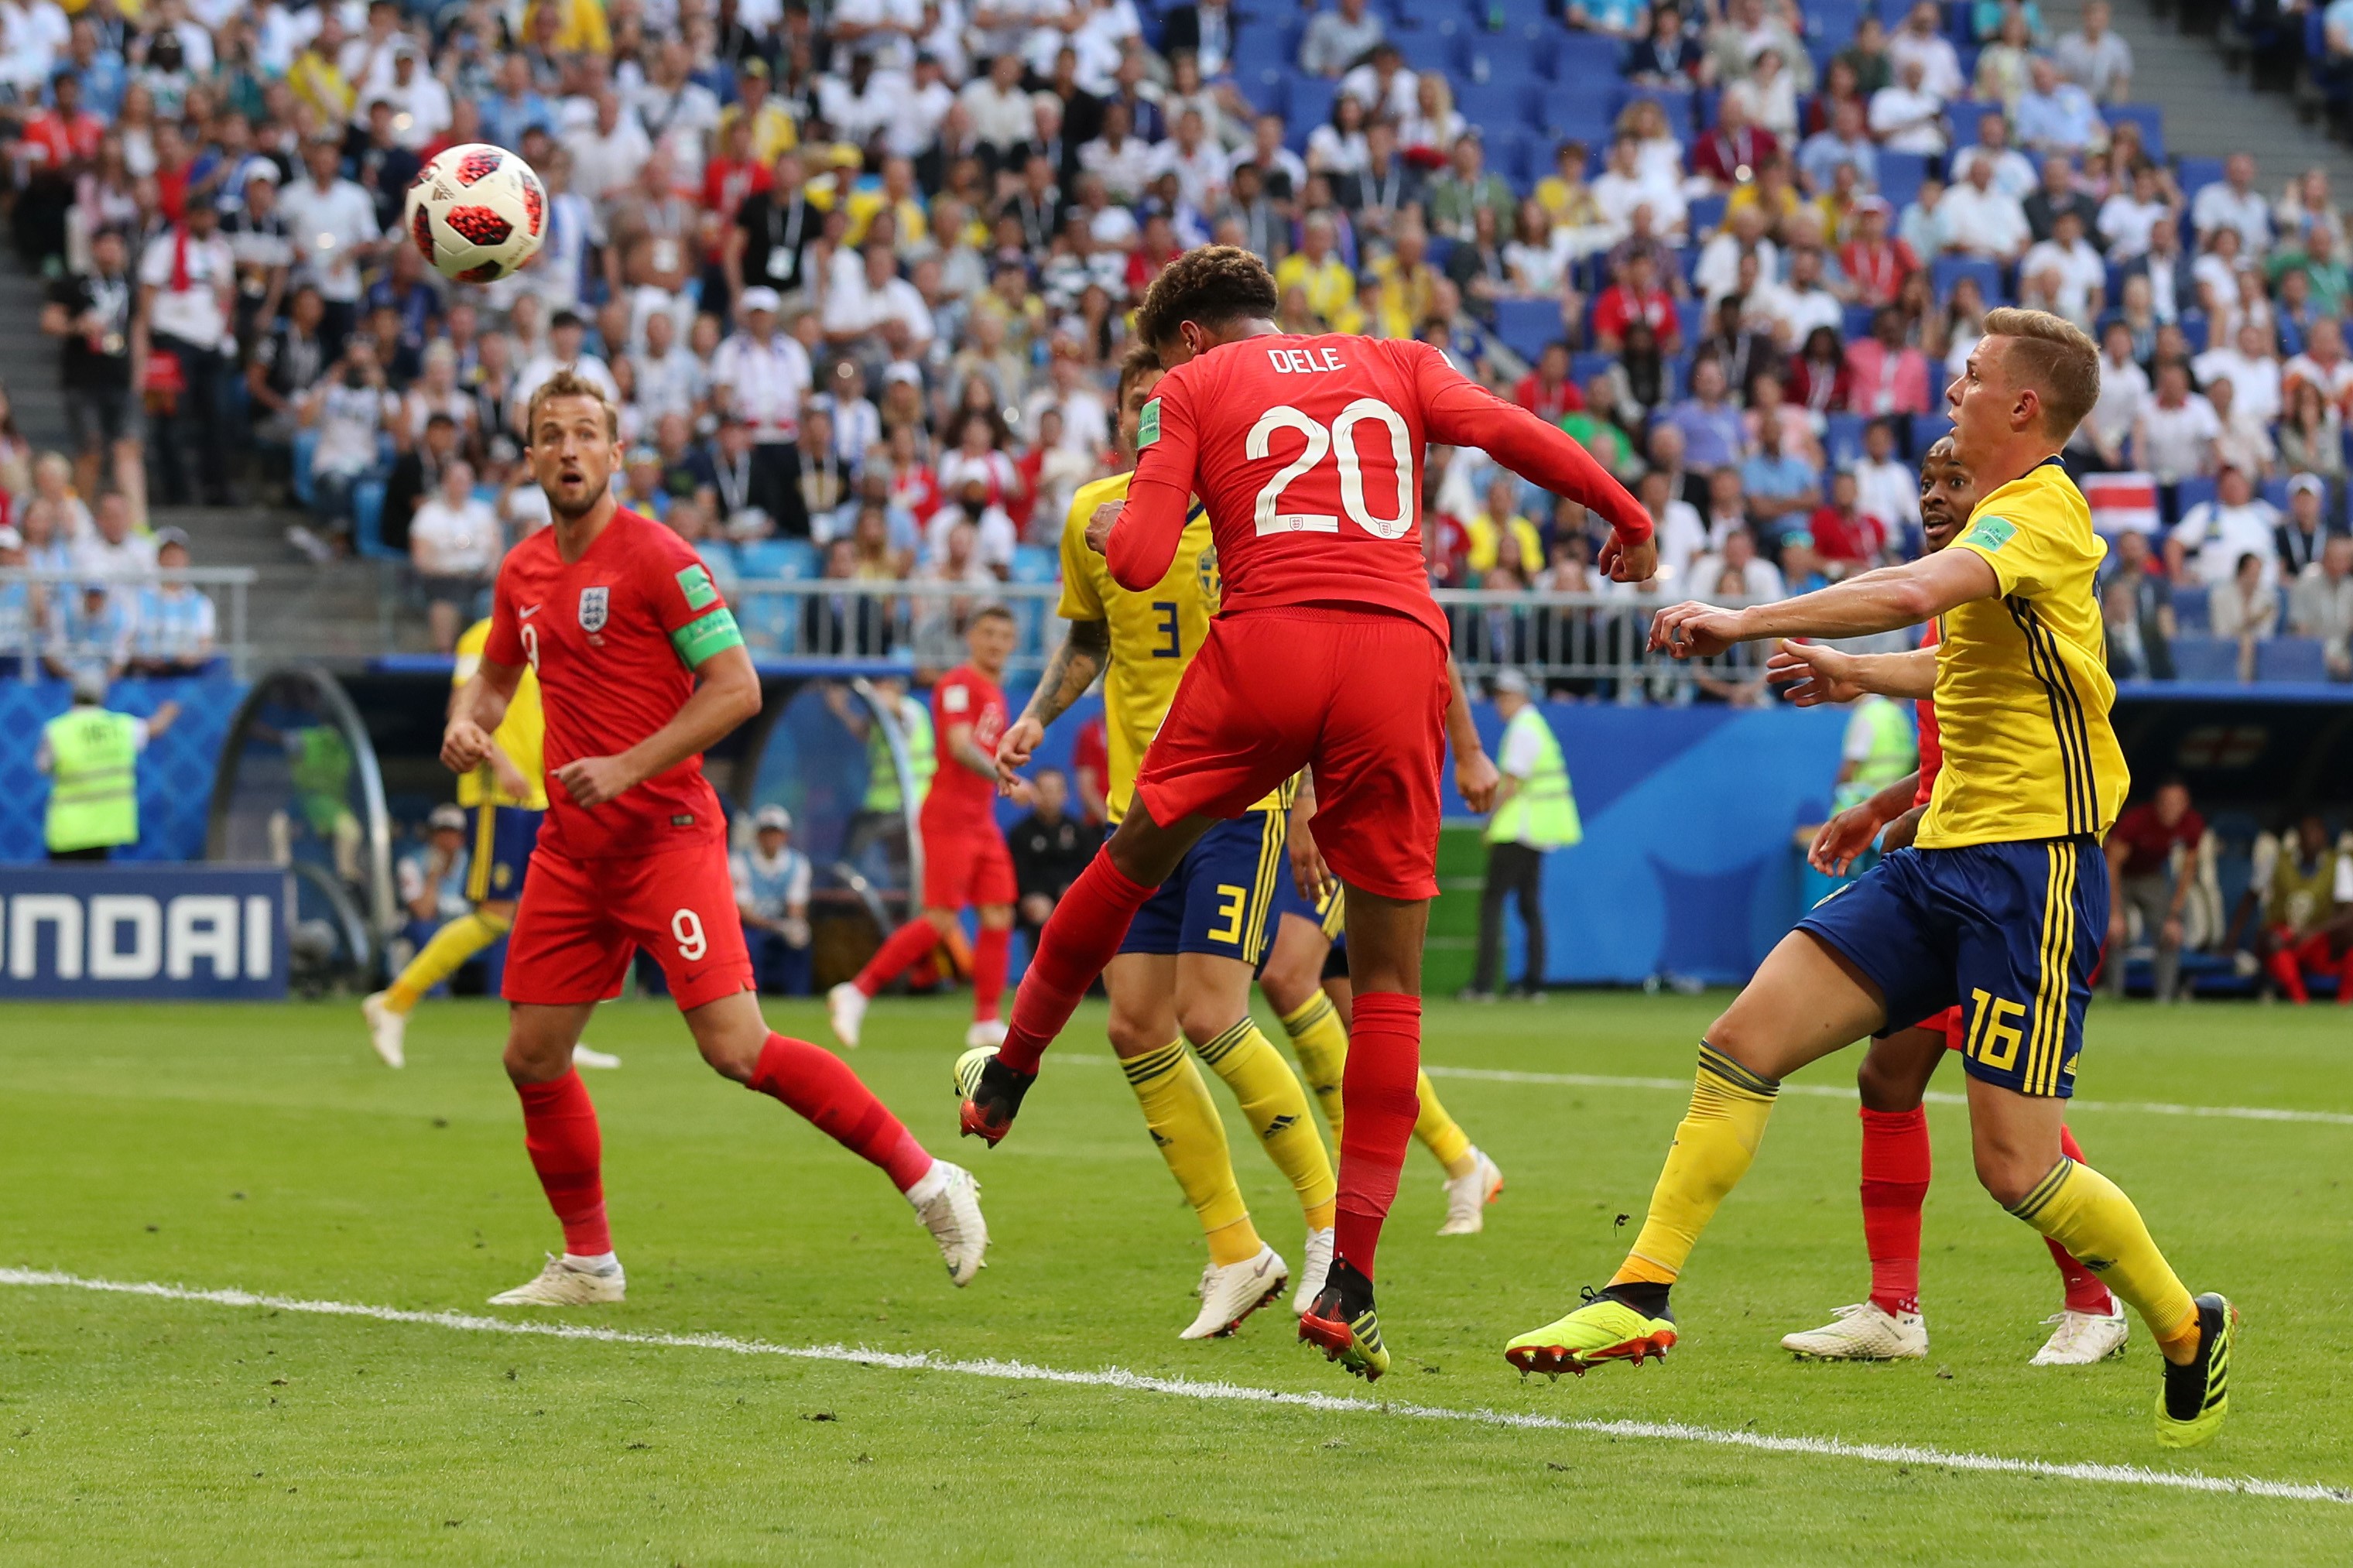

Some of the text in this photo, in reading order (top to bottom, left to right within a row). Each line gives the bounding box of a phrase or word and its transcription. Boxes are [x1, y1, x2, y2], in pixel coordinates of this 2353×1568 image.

[1267, 347, 1346, 373] DELE
[1245, 398, 1413, 539] 20
[520, 623, 539, 674] 9
[1152, 602, 1180, 657] 3
[0, 894, 272, 981] NDAI
[671, 908, 707, 961] 9
[1207, 884, 1247, 944] 3
[1967, 987, 2026, 1072] 16
